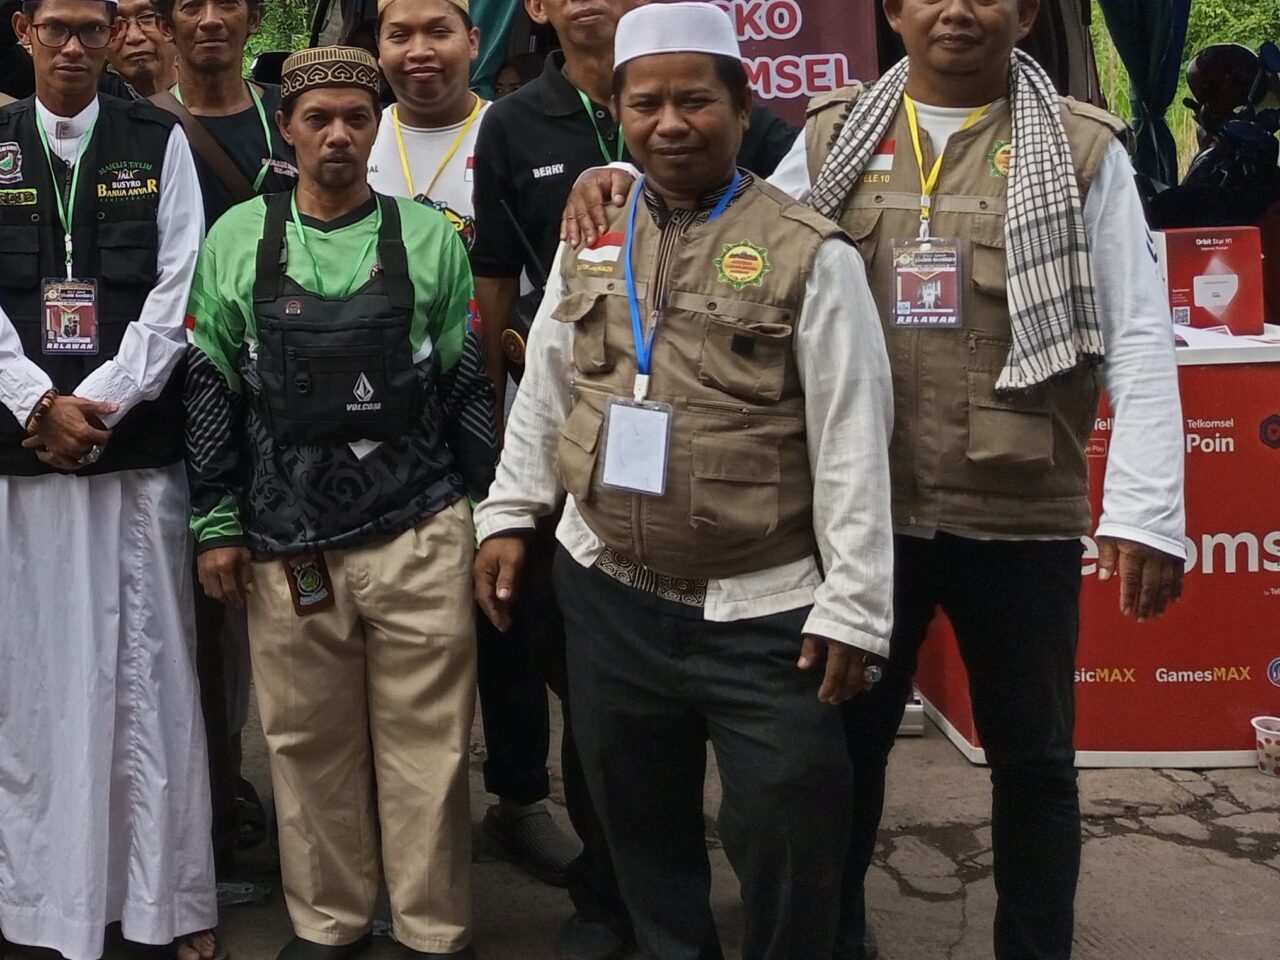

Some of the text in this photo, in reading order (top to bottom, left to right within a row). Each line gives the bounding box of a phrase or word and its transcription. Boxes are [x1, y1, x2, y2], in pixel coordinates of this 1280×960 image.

[532, 164, 564, 178] BERRY
[880, 174, 890, 182] 10
[112, 180, 141, 188] BUSYRO
[896, 316, 956, 324] RELAWAN
[346, 403, 382, 411] VOLCOM
[1187, 418, 1234, 428] Telkomsel
[1186, 433, 1234, 453] Poin
[1155, 666, 1251, 683] GamesMAX
